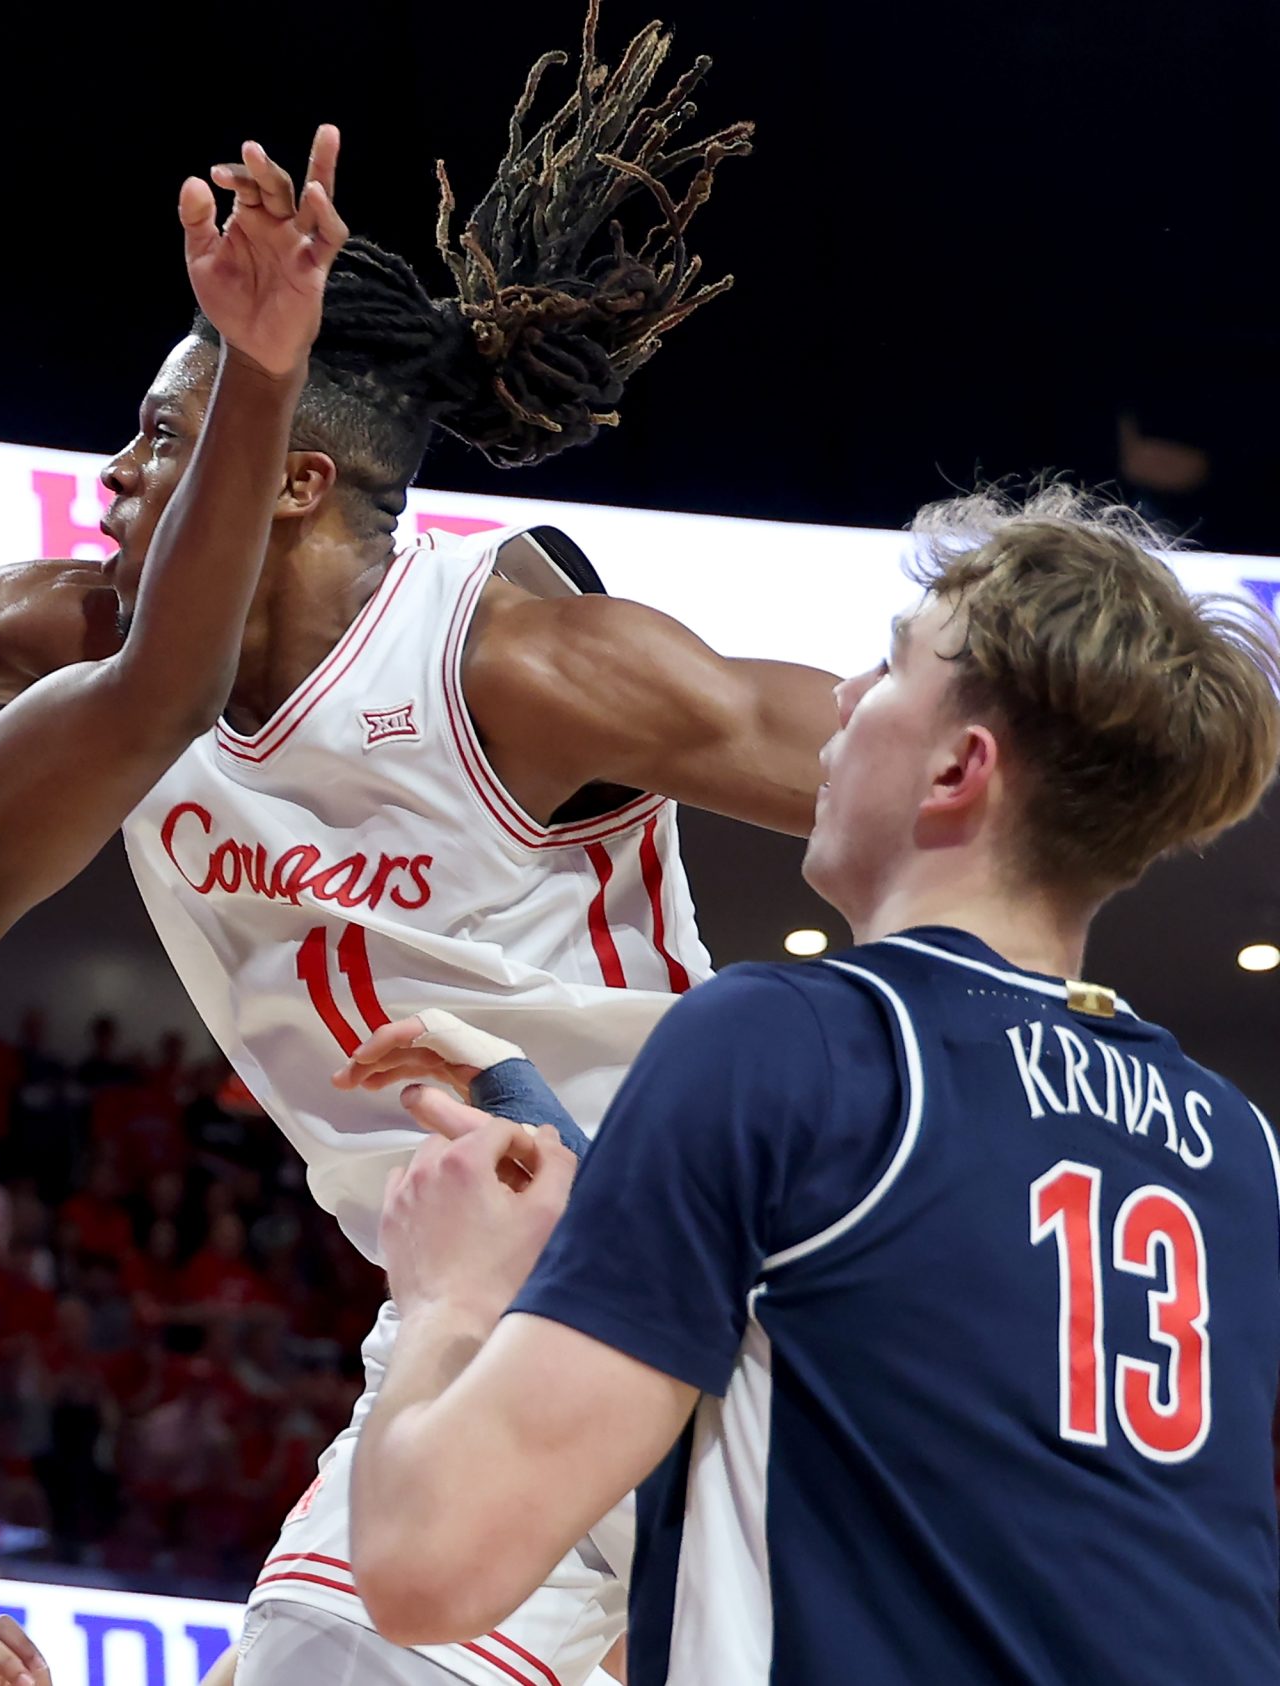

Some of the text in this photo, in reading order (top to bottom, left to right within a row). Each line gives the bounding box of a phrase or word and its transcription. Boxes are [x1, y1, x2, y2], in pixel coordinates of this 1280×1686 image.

[161, 802, 433, 910] Cougars
[296, 922, 393, 1058] 11
[1006, 1021, 1213, 1169] KRIVAS
[1030, 1160, 1212, 1463] 13
